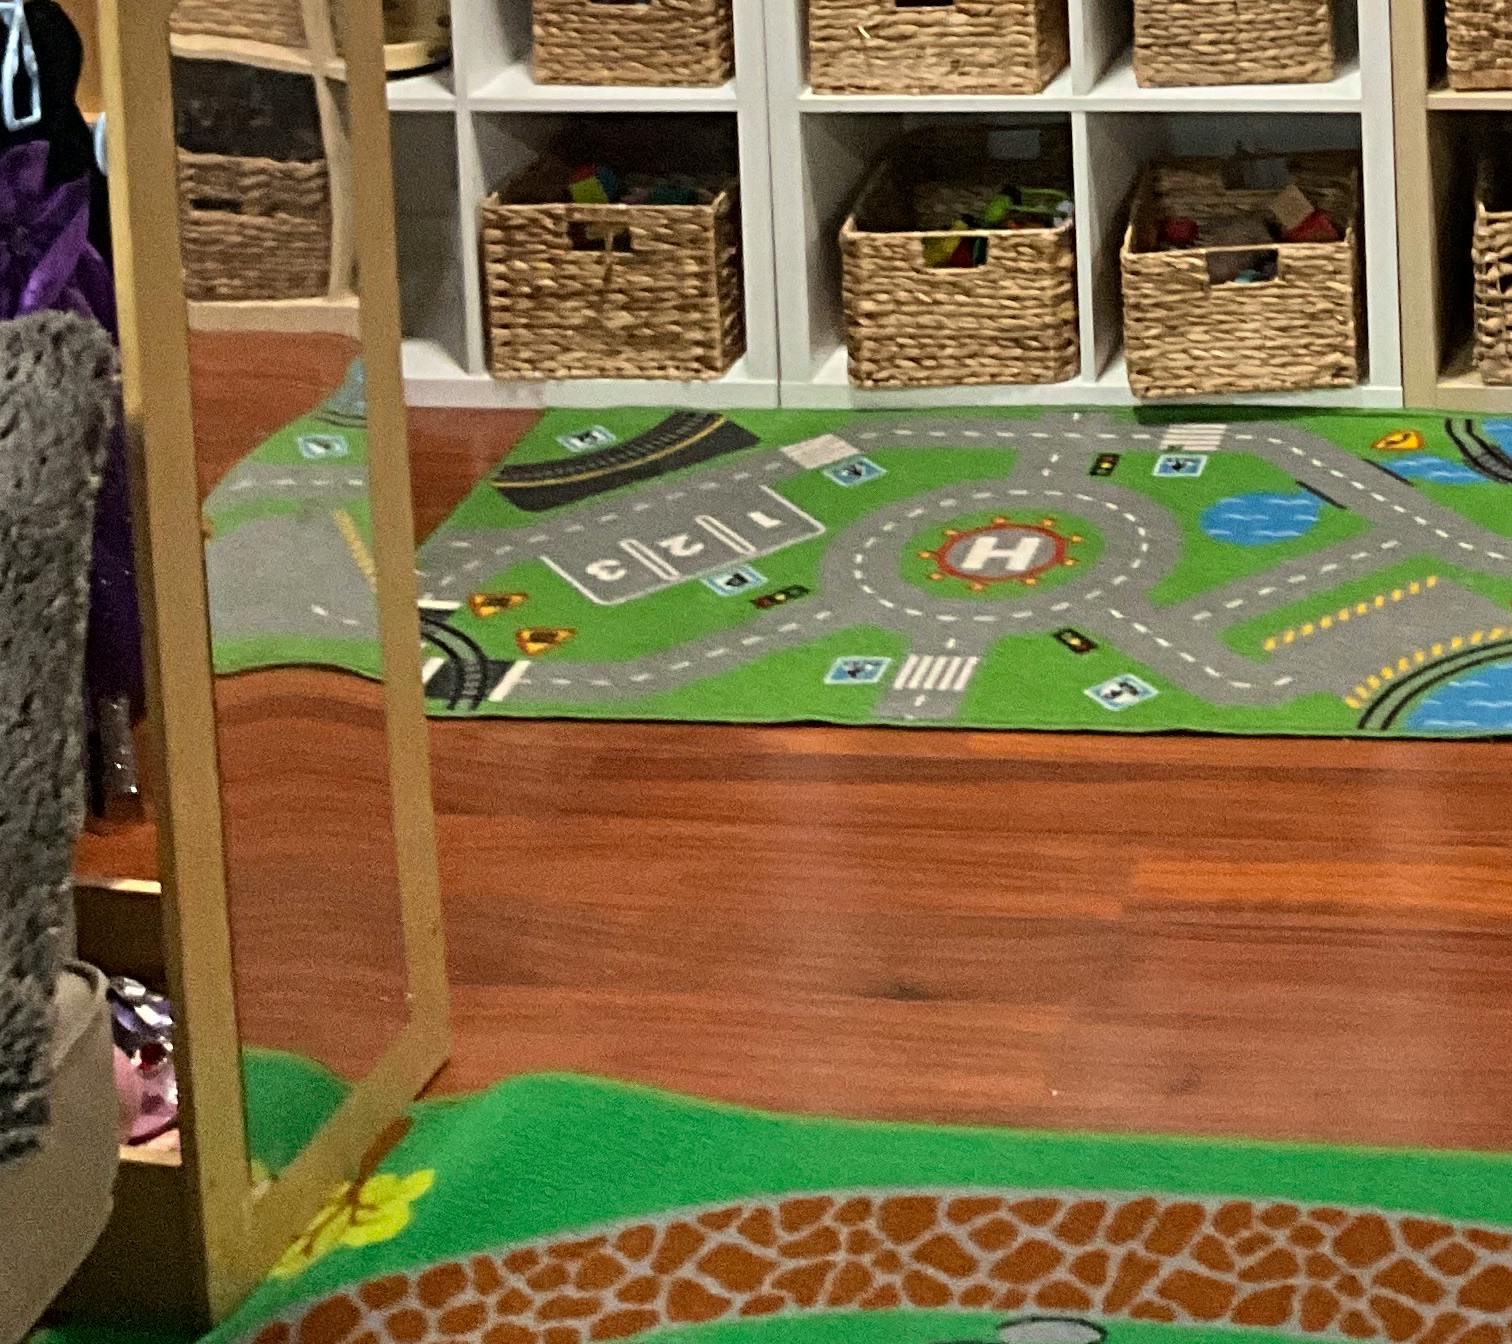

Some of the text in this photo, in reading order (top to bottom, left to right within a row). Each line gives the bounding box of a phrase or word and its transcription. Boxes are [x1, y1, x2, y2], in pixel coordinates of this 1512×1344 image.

[659, 532, 705, 558] 2
[960, 536, 1042, 572] H
[584, 558, 627, 582] 3
